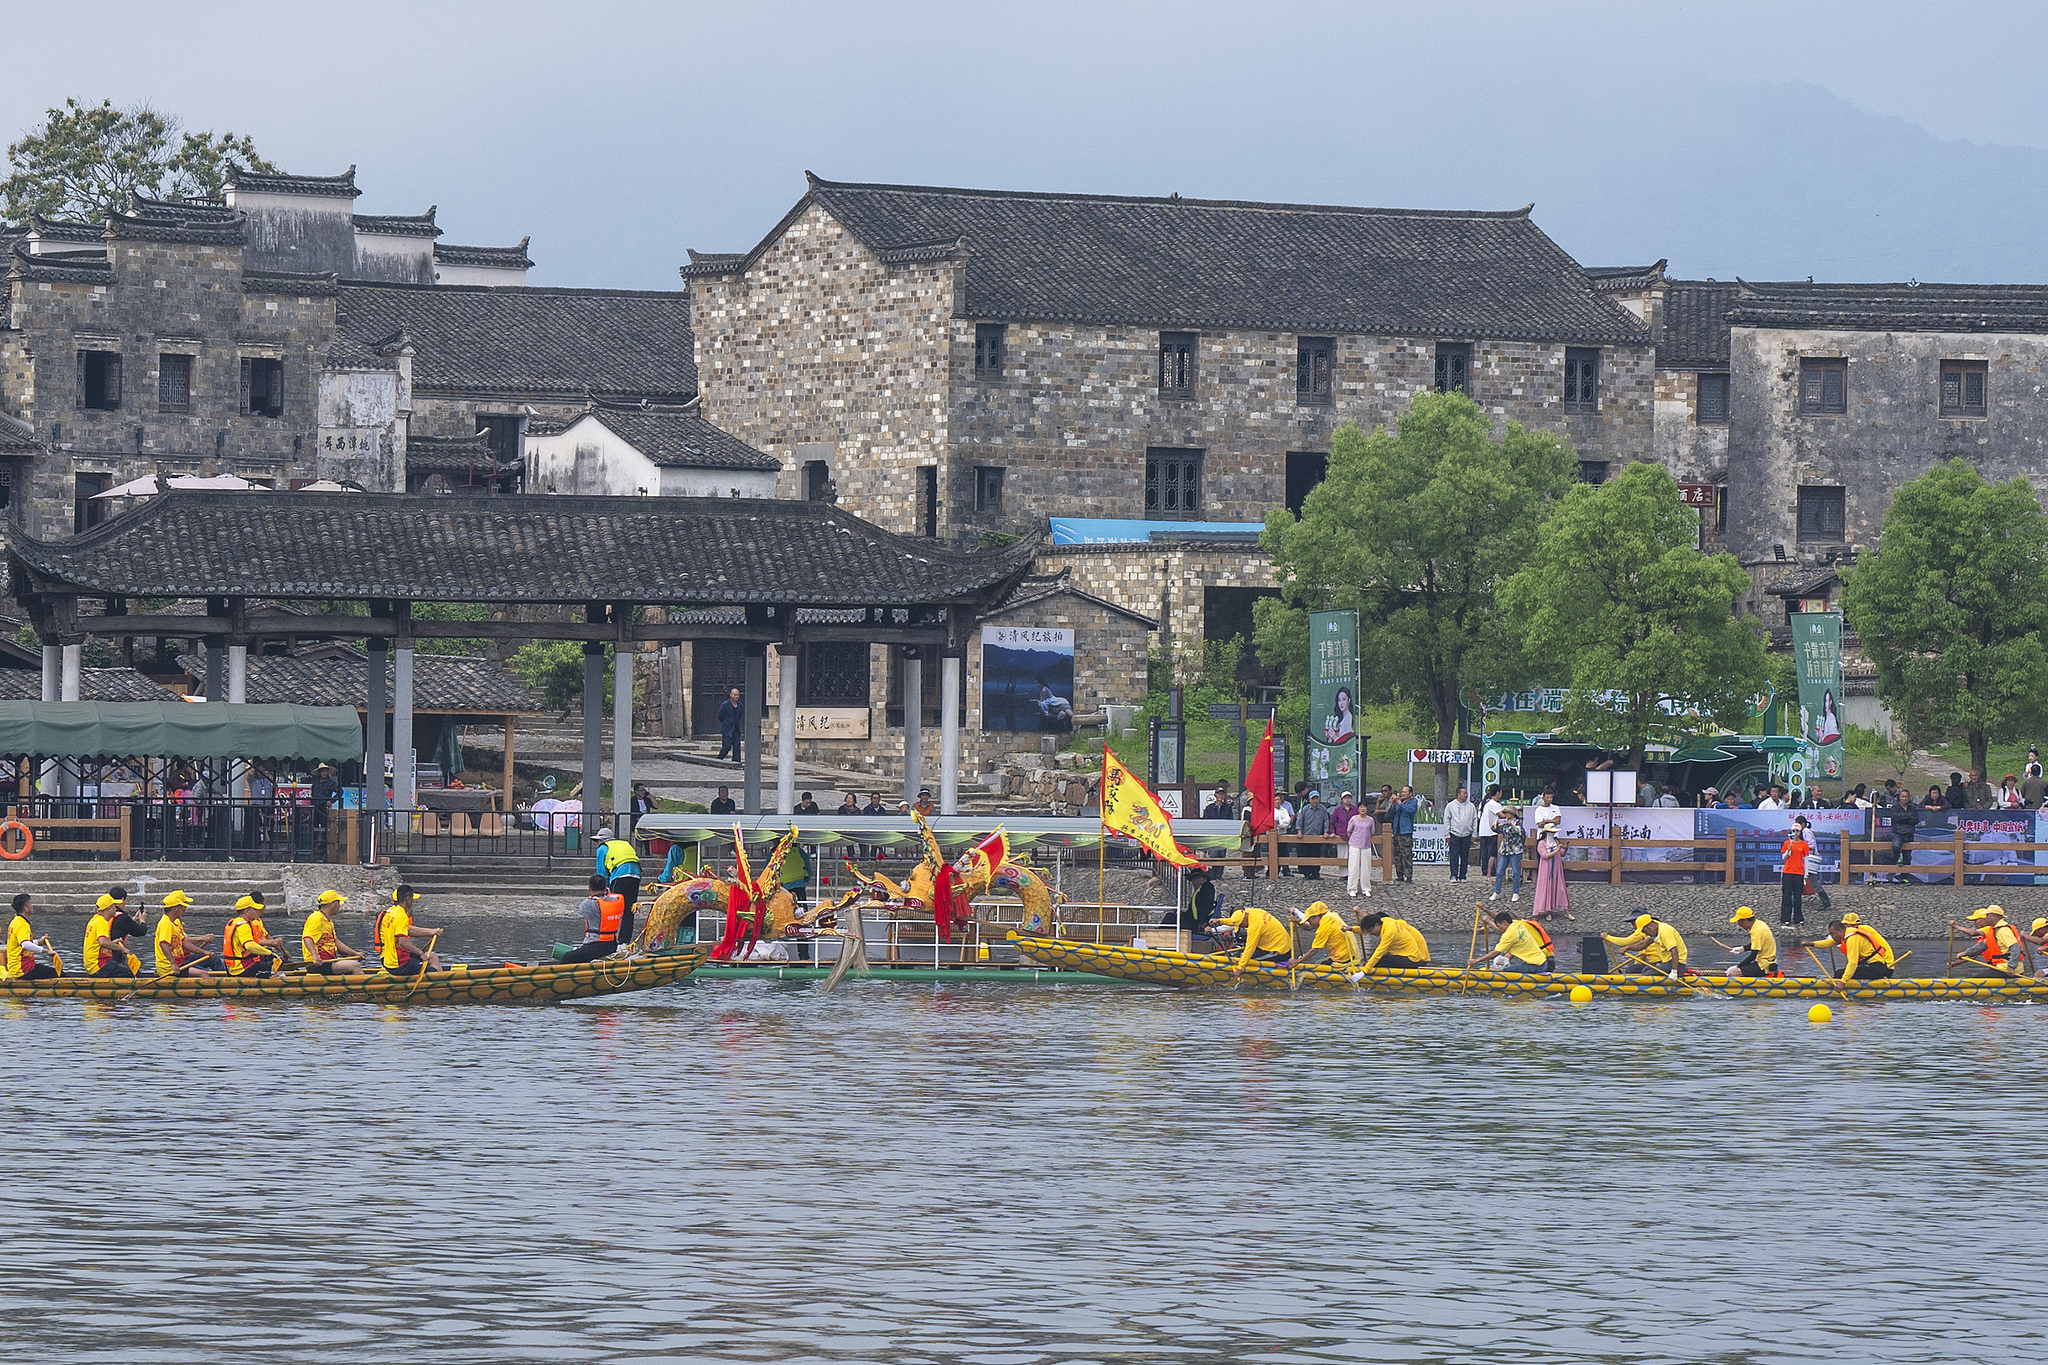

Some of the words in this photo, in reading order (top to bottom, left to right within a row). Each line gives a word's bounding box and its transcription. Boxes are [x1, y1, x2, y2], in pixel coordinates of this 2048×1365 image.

[1428, 750, 1474, 763] 桃花潭站
[1613, 823, 1651, 840] 卷江南
[1957, 820, 1990, 832] 人类非遗
[1993, 820, 2024, 832] 中国宣纸
